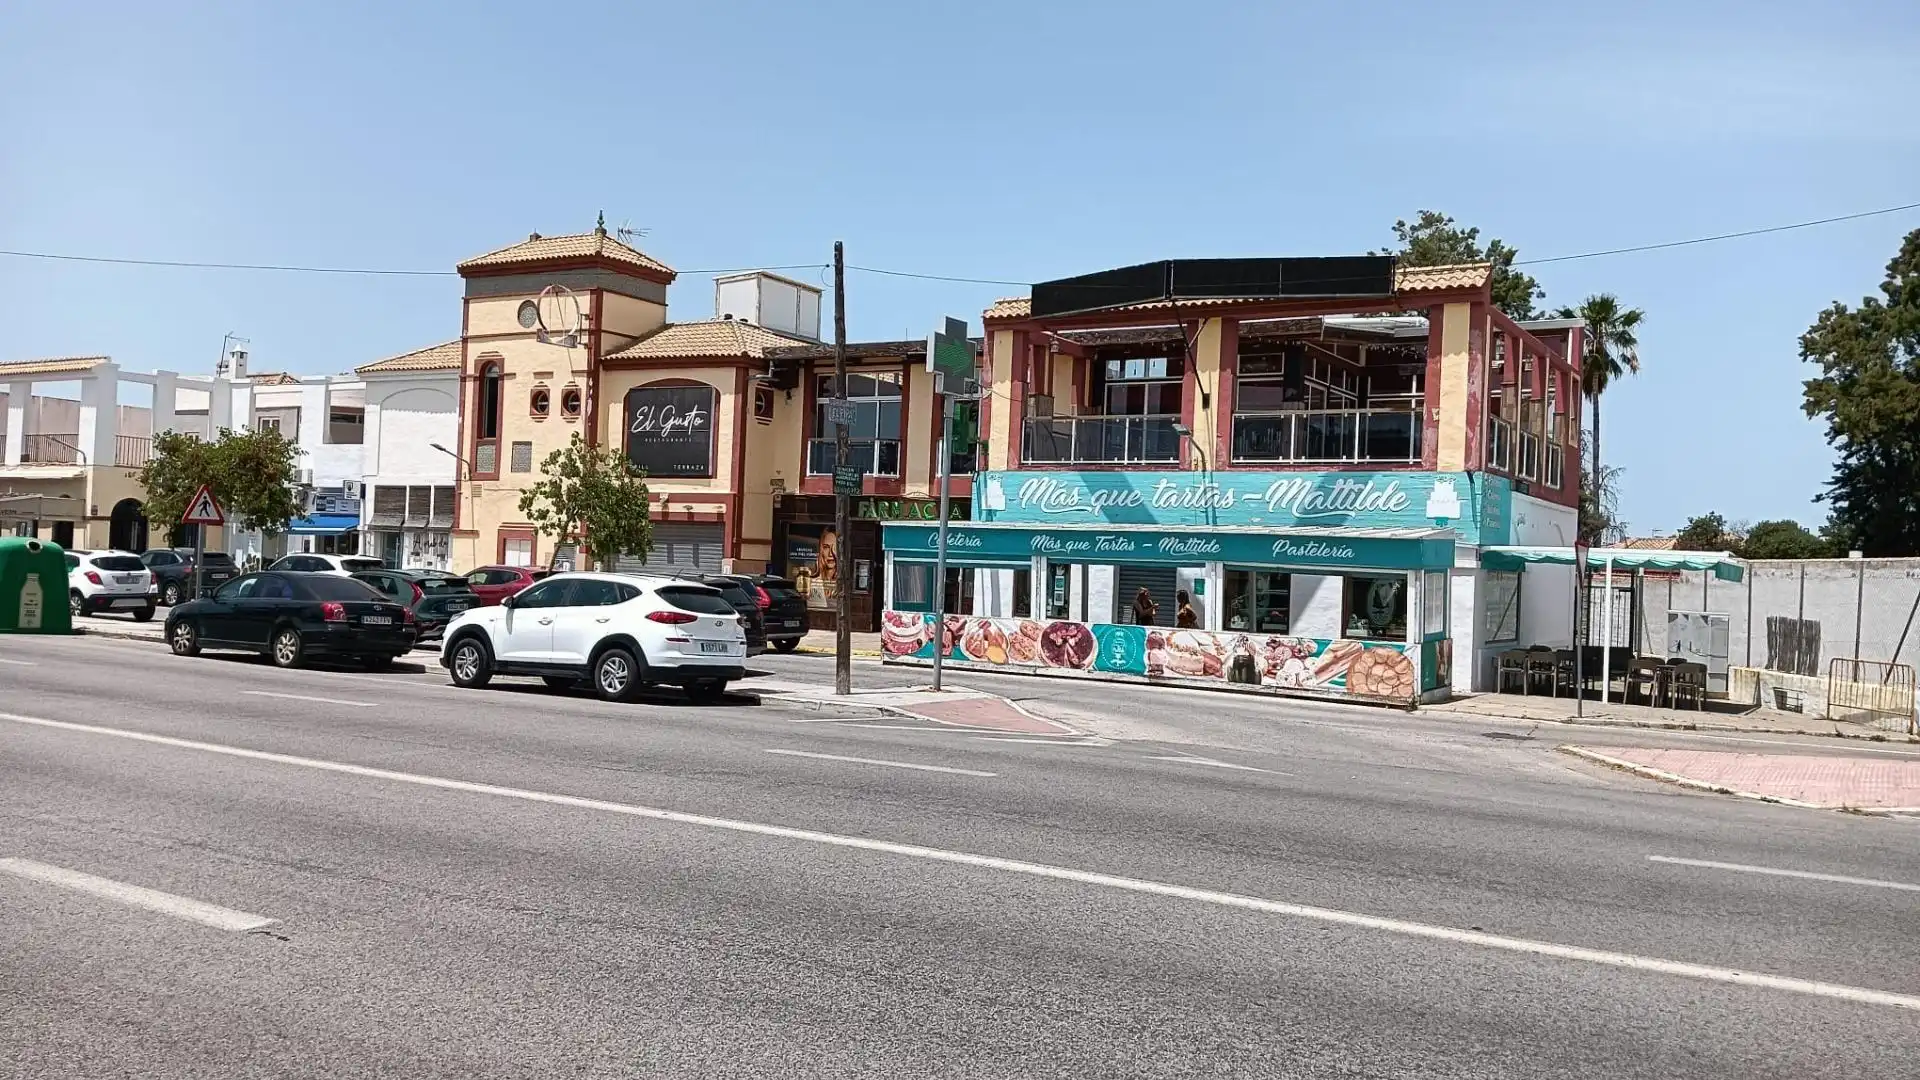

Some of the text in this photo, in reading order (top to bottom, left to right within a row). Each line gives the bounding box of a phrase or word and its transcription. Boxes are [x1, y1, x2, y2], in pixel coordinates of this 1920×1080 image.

[631, 404, 707, 437] El Gusto
[1018, 477, 1092, 514] Más
[1091, 488, 1145, 517] que
[1151, 477, 1236, 510] tartas
[858, 500, 962, 520] FARMACA
[1030, 534, 1067, 553] Más
[1065, 540, 1091, 554] que
[1095, 535, 1135, 552] Tartas
[1272, 539, 1356, 558] Pastelería
